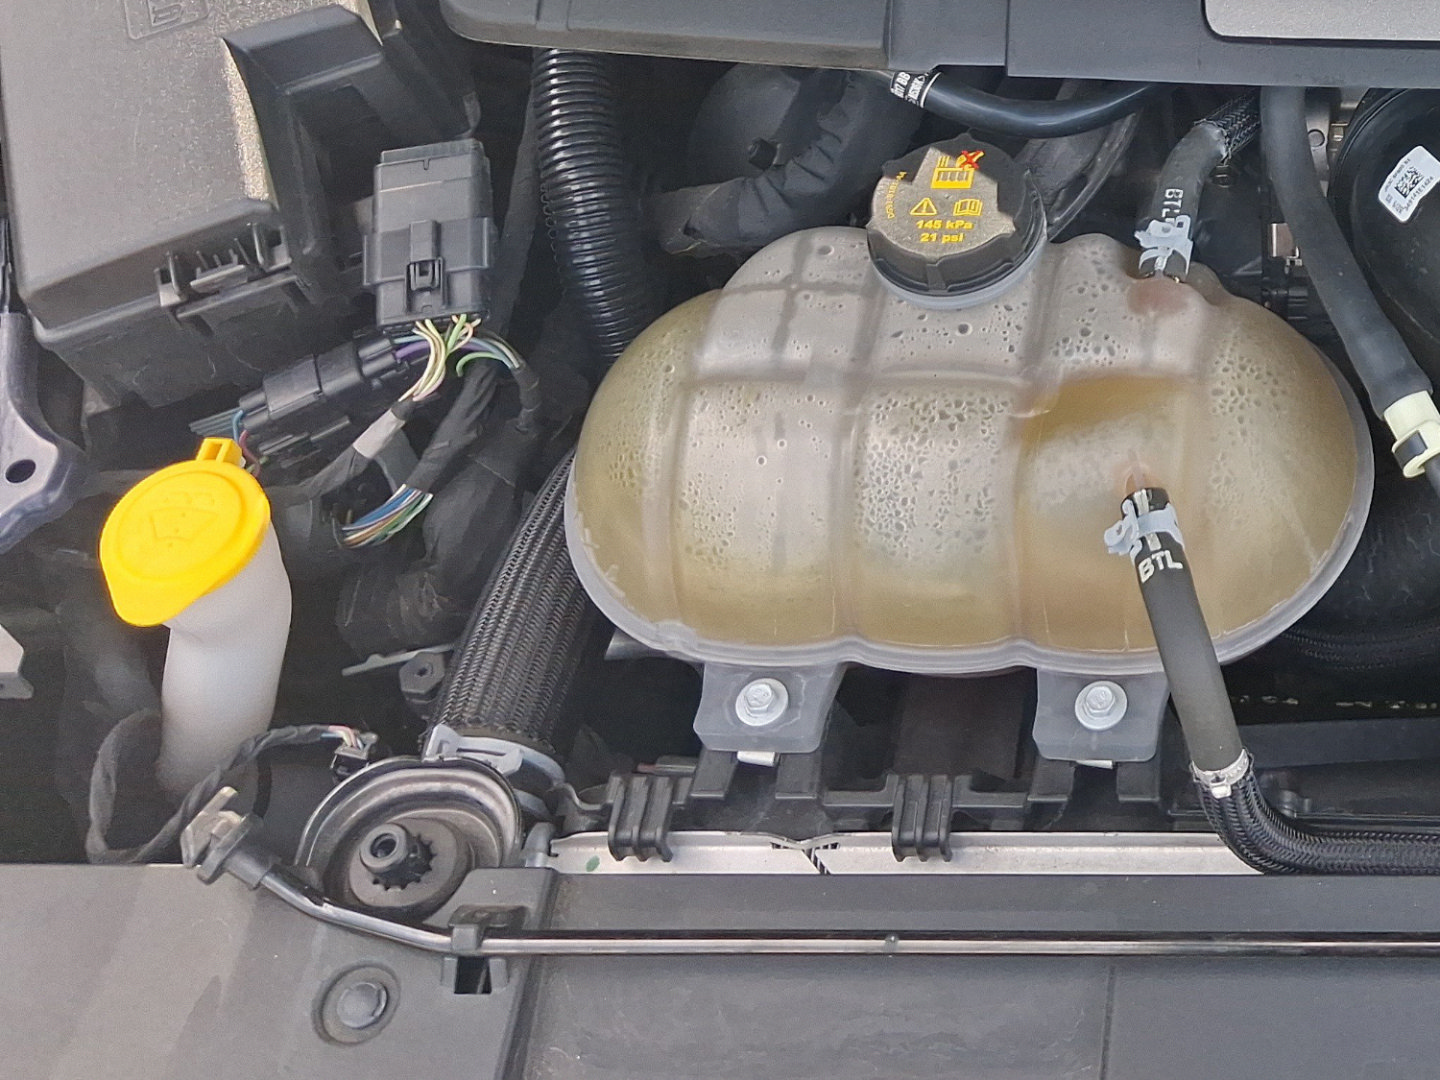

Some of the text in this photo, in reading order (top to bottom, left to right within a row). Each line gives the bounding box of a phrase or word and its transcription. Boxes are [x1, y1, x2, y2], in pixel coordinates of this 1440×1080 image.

[916, 219, 974, 230] 145 kPa
[920, 233, 965, 244] 21 psi
[1138, 550, 1183, 583] BTL
